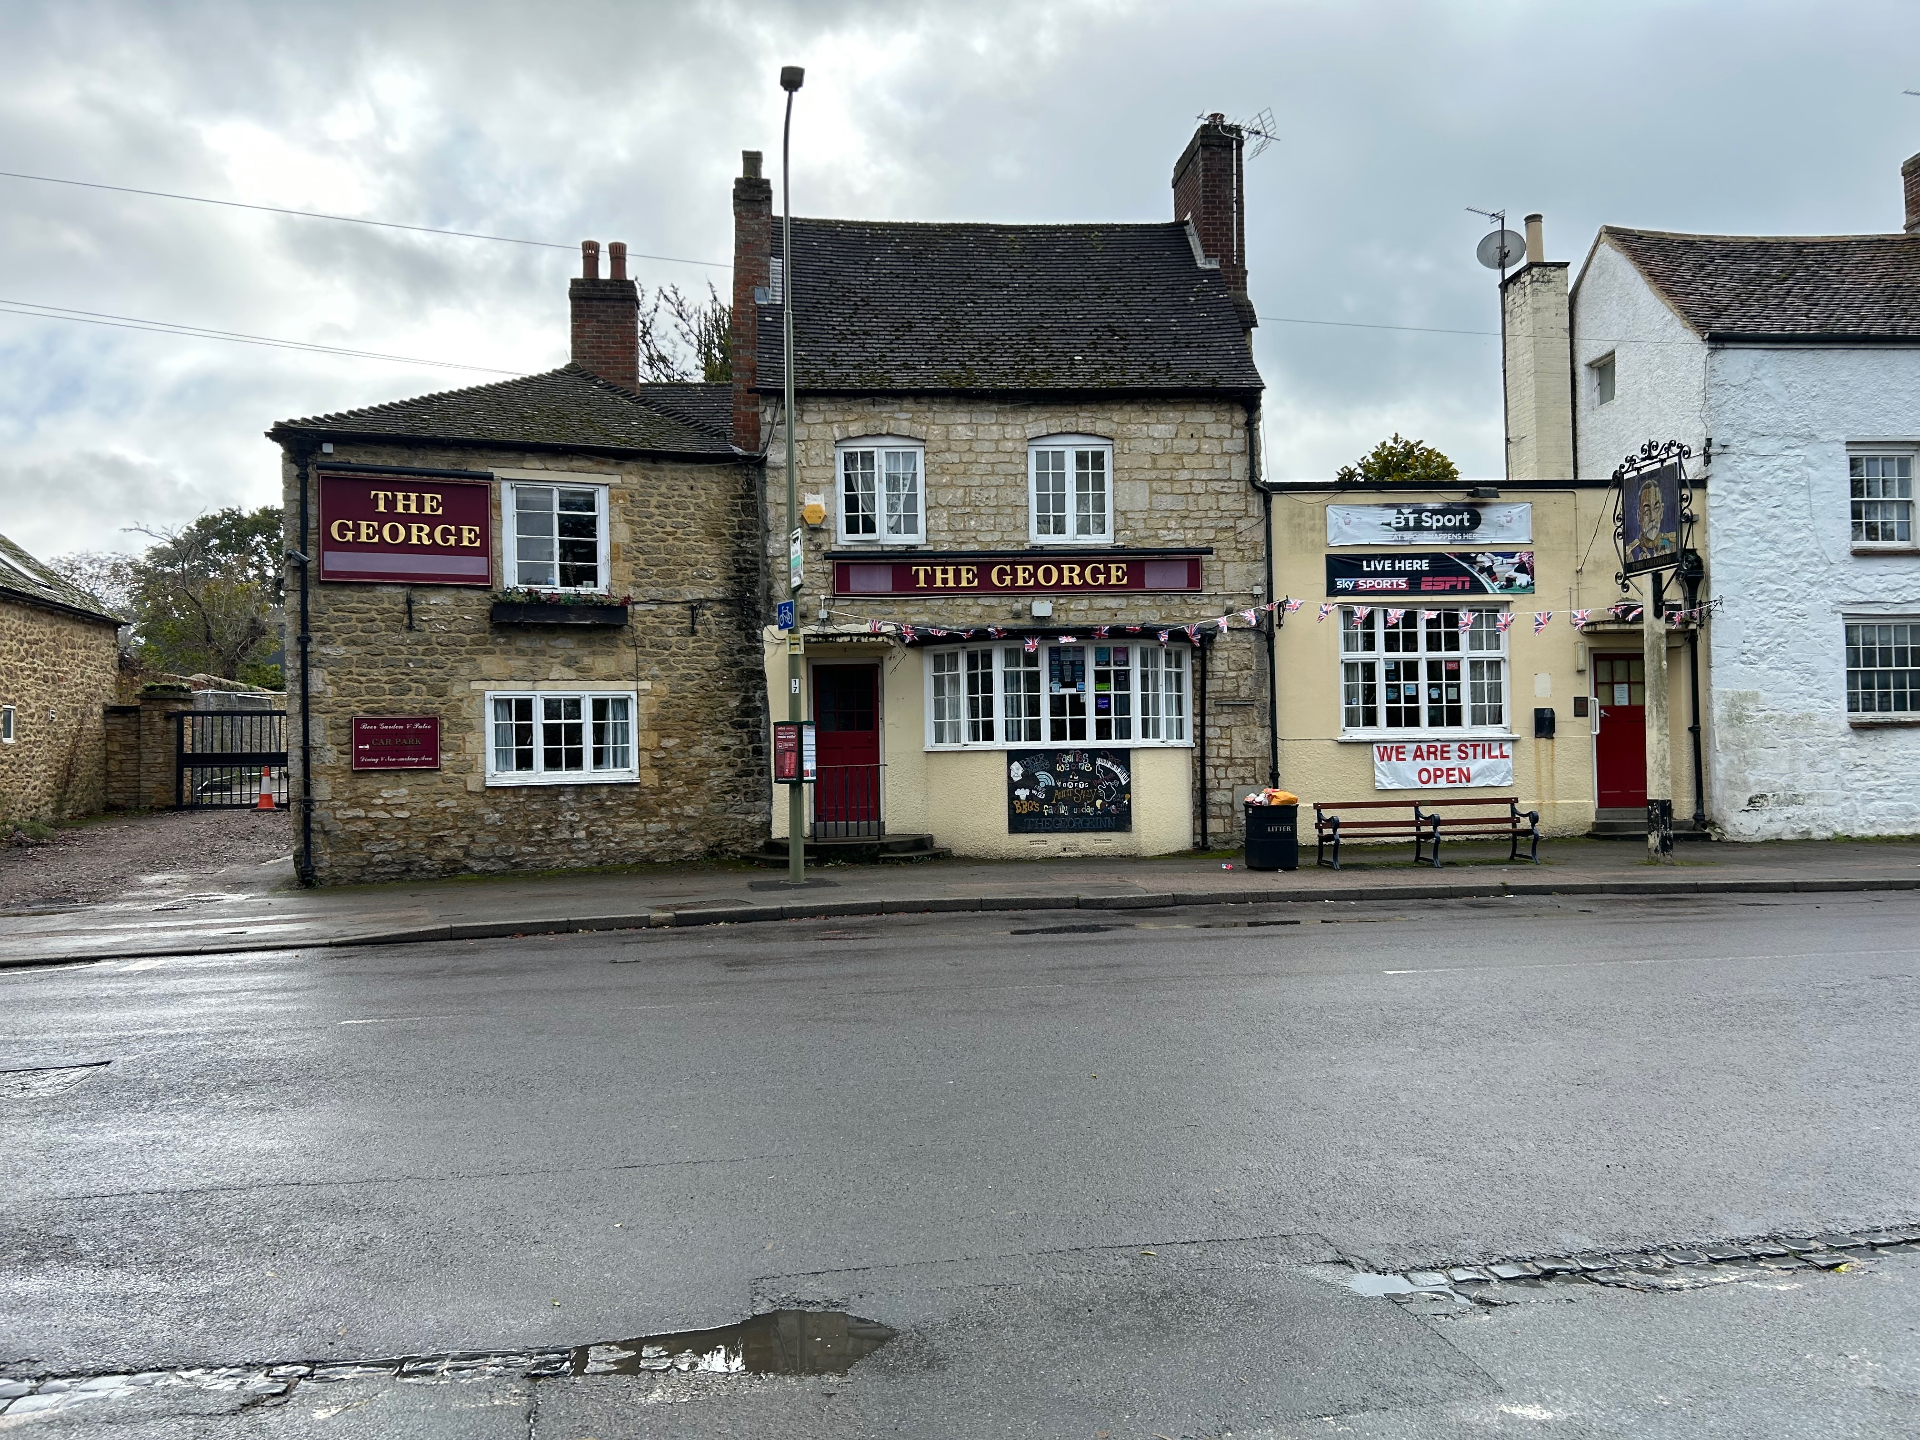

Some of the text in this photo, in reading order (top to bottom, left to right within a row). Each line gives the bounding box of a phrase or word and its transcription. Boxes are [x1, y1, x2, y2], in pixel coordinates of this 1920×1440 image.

[371, 490, 443, 515] THE
[1391, 511, 1470, 530] BT Sport
[330, 519, 481, 547] GEORGE
[1362, 559, 1430, 571] LIVE HERE
[911, 563, 1128, 588] THE GEORGE
[1336, 577, 1470, 591] sky SPORTS ESPN
[371, 738, 392, 746] CAR
[1376, 743, 1510, 762] WE ARE STILL
[1417, 767, 1471, 784] OPEN
